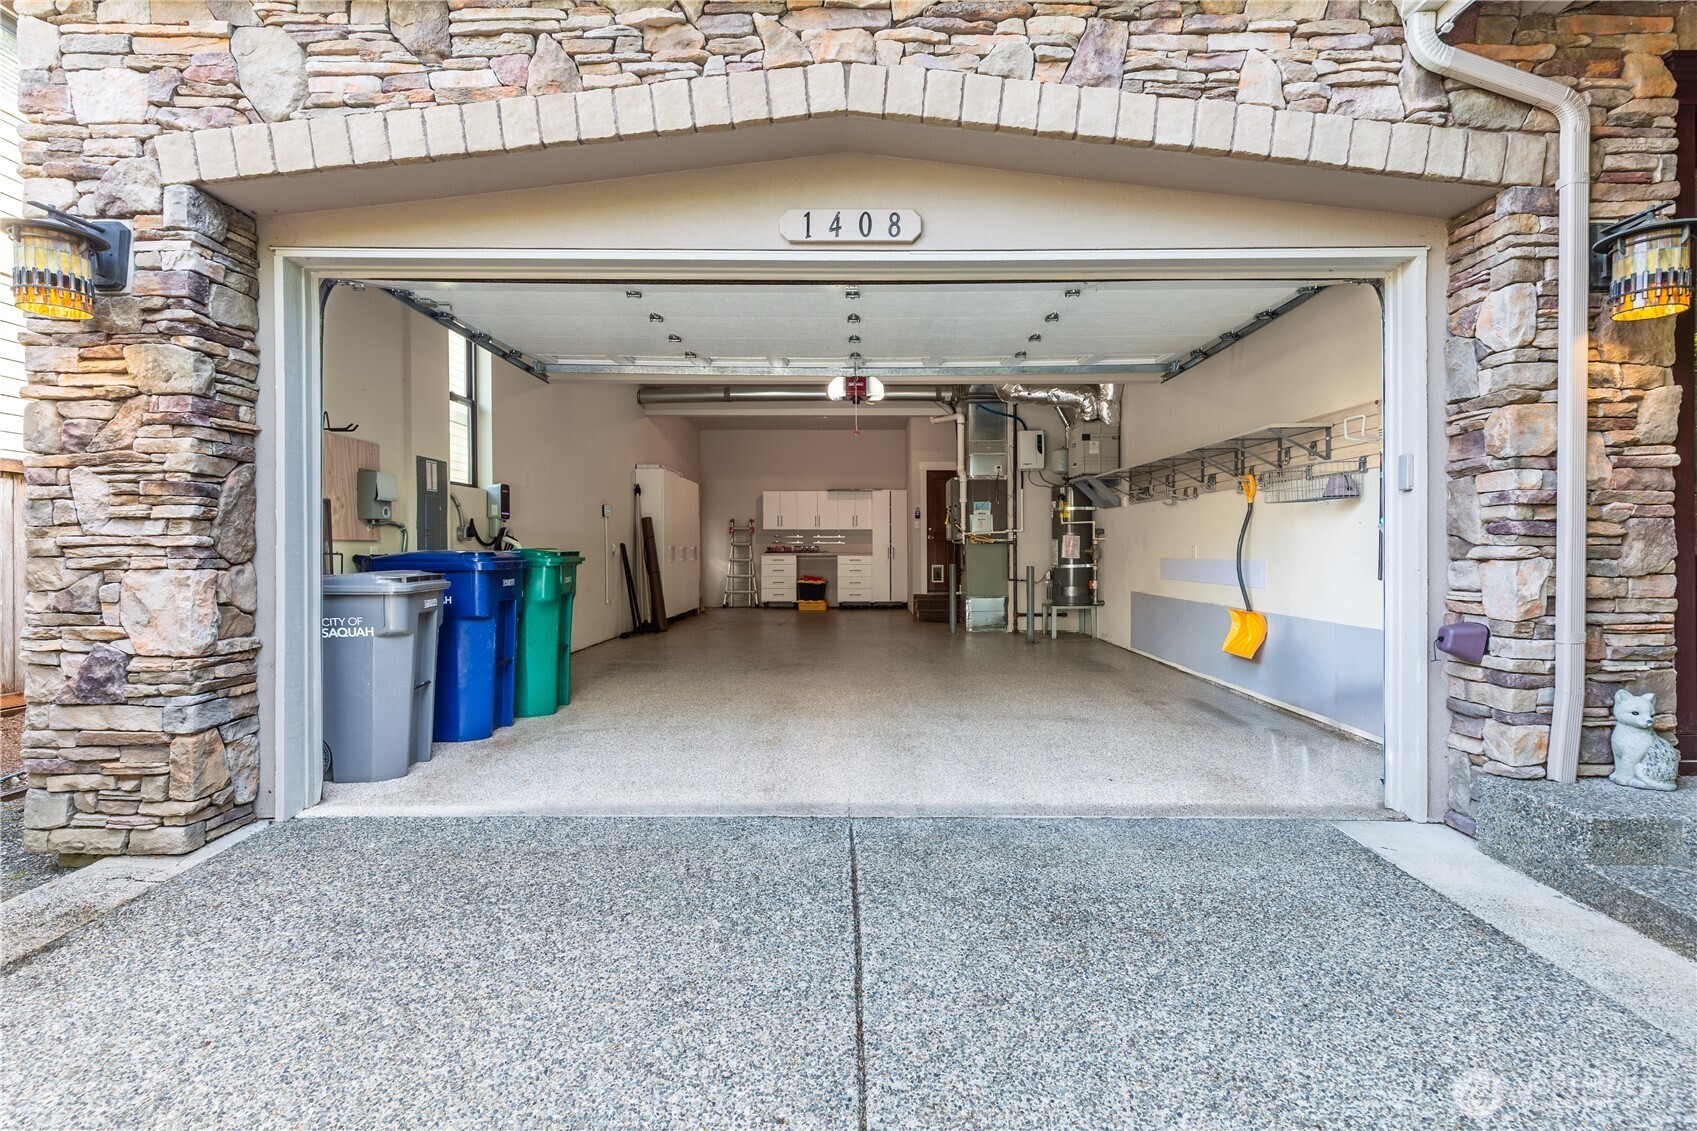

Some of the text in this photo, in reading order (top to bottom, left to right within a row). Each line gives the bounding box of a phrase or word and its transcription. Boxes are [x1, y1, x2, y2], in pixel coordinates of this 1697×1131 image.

[803, 211, 901, 239] 1408
[322, 616, 363, 627] CITY OF
